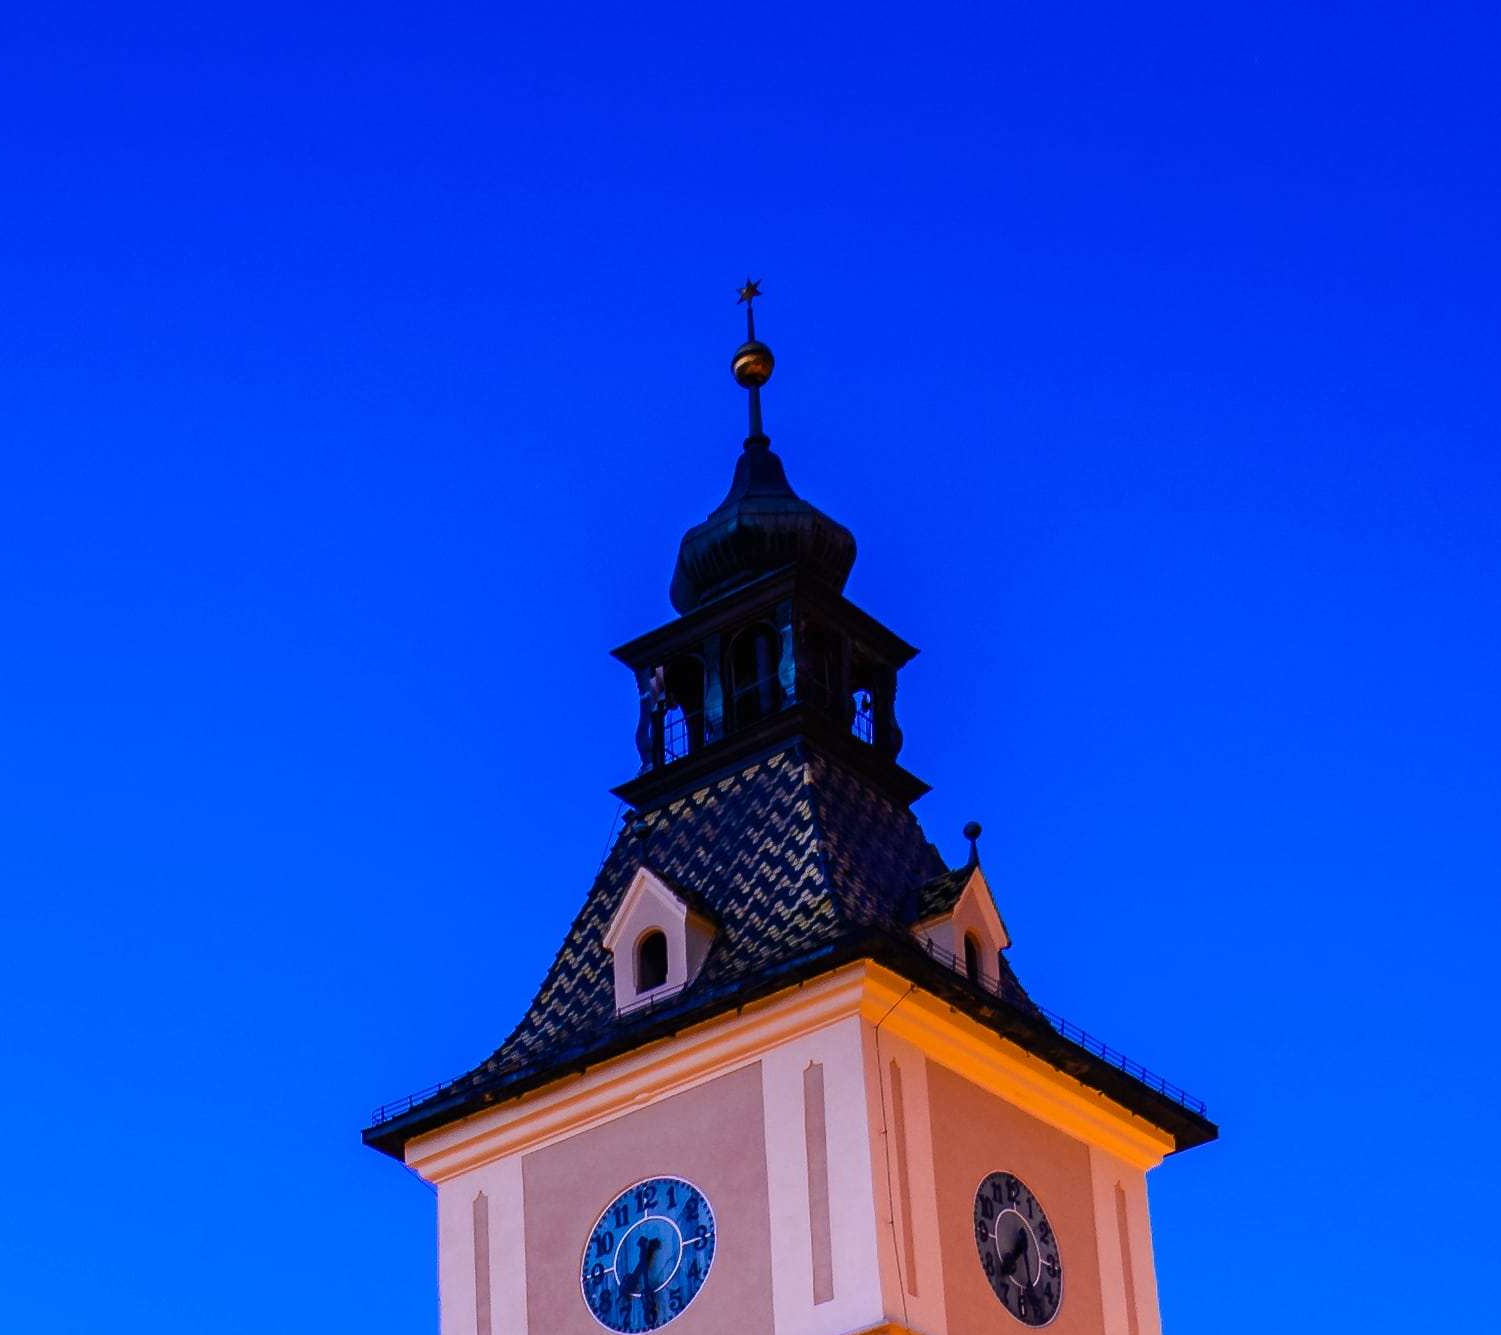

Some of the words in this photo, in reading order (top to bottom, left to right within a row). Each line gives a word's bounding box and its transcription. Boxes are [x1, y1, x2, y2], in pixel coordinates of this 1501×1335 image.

[666, 1185, 677, 1209] 1
[992, 1181, 1003, 1204] 11
[613, 1204, 629, 1228] 11
[684, 1196, 699, 1220] 2
[980, 1194, 994, 1219] 10
[1026, 1198, 1033, 1219] 1
[591, 1231, 614, 1258] 10
[1038, 1221, 1049, 1245] 2
[688, 1260, 703, 1280] 4
[599, 1289, 613, 1313] 8
[669, 1288, 683, 1311] 5
